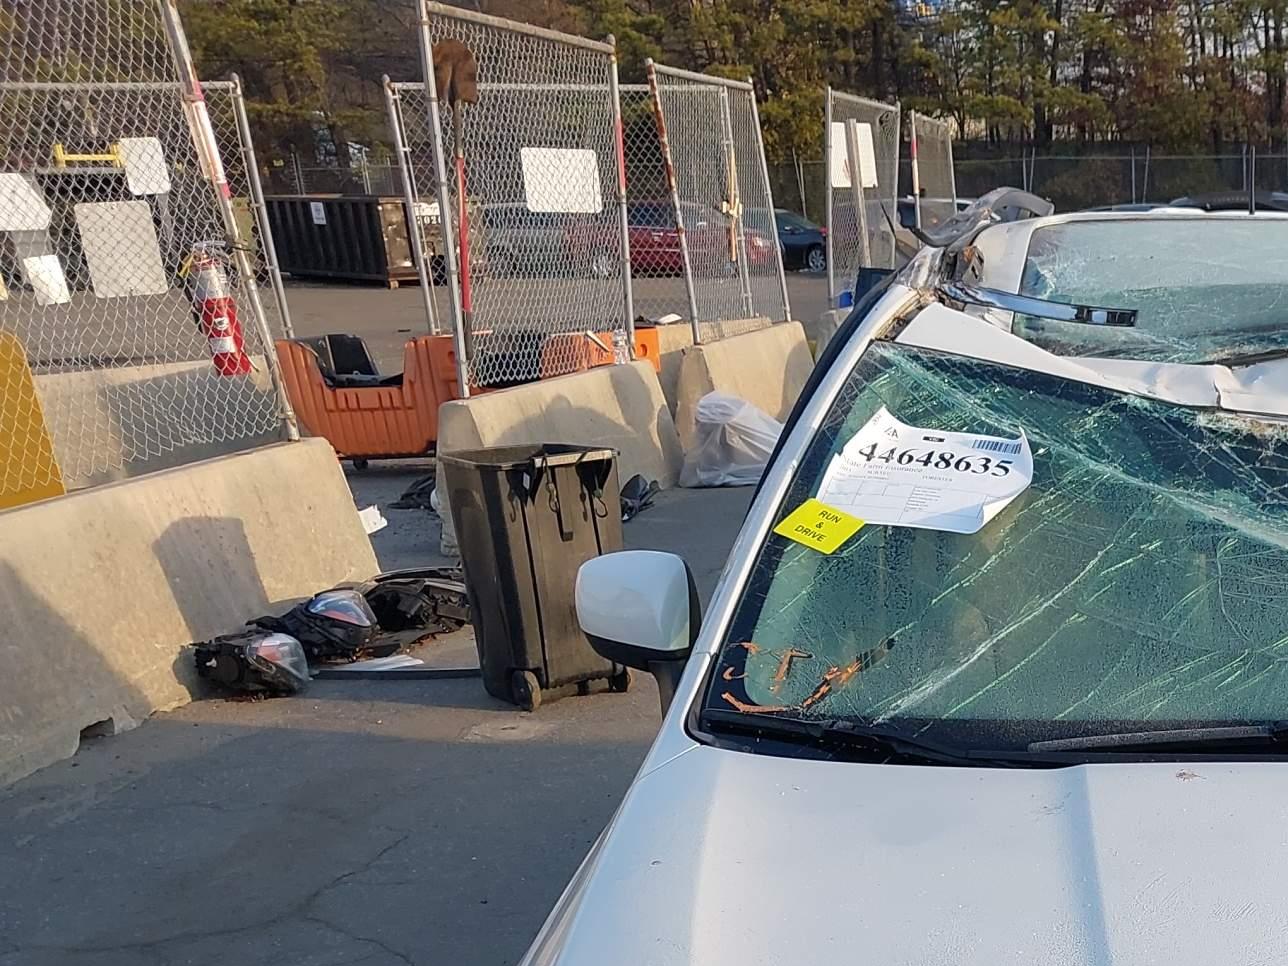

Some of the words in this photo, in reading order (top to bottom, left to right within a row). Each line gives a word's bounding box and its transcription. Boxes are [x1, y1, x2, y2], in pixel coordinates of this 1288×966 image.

[859, 442, 1013, 478] 44648635
[818, 510, 842, 523] RUN
[815, 521, 824, 529] &
[794, 524, 827, 542] DRIVE
